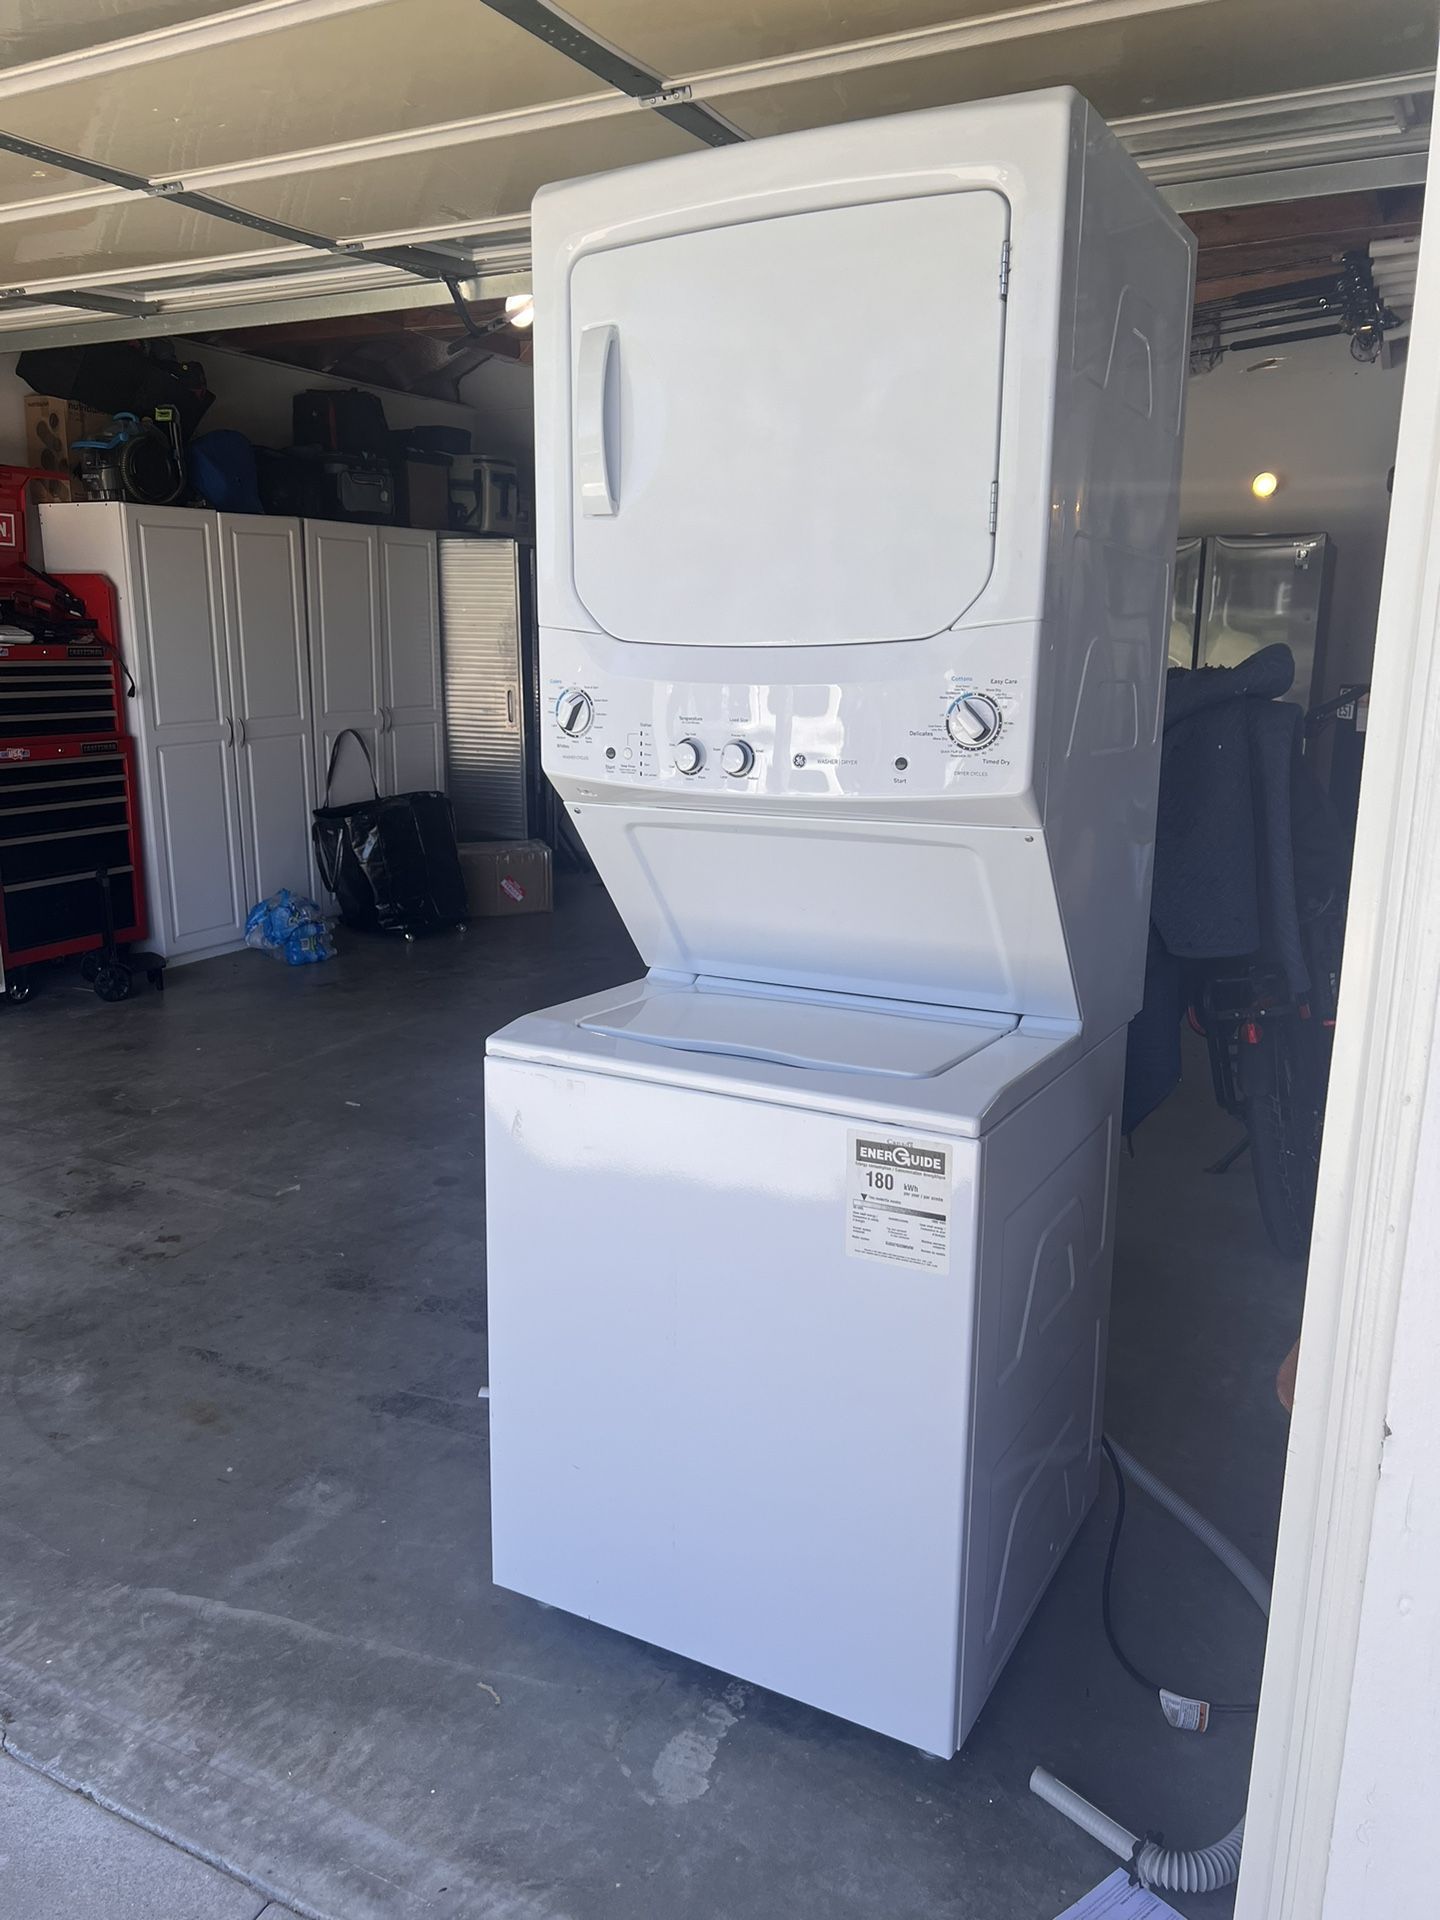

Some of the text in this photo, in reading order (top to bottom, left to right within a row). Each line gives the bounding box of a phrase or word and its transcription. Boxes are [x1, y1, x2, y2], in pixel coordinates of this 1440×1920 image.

[990, 678, 1003, 686] Easy
[859, 1147, 942, 1170] ENERGUIDE
[865, 1170, 895, 1191] 180
[903, 1183, 919, 1193] kWh
